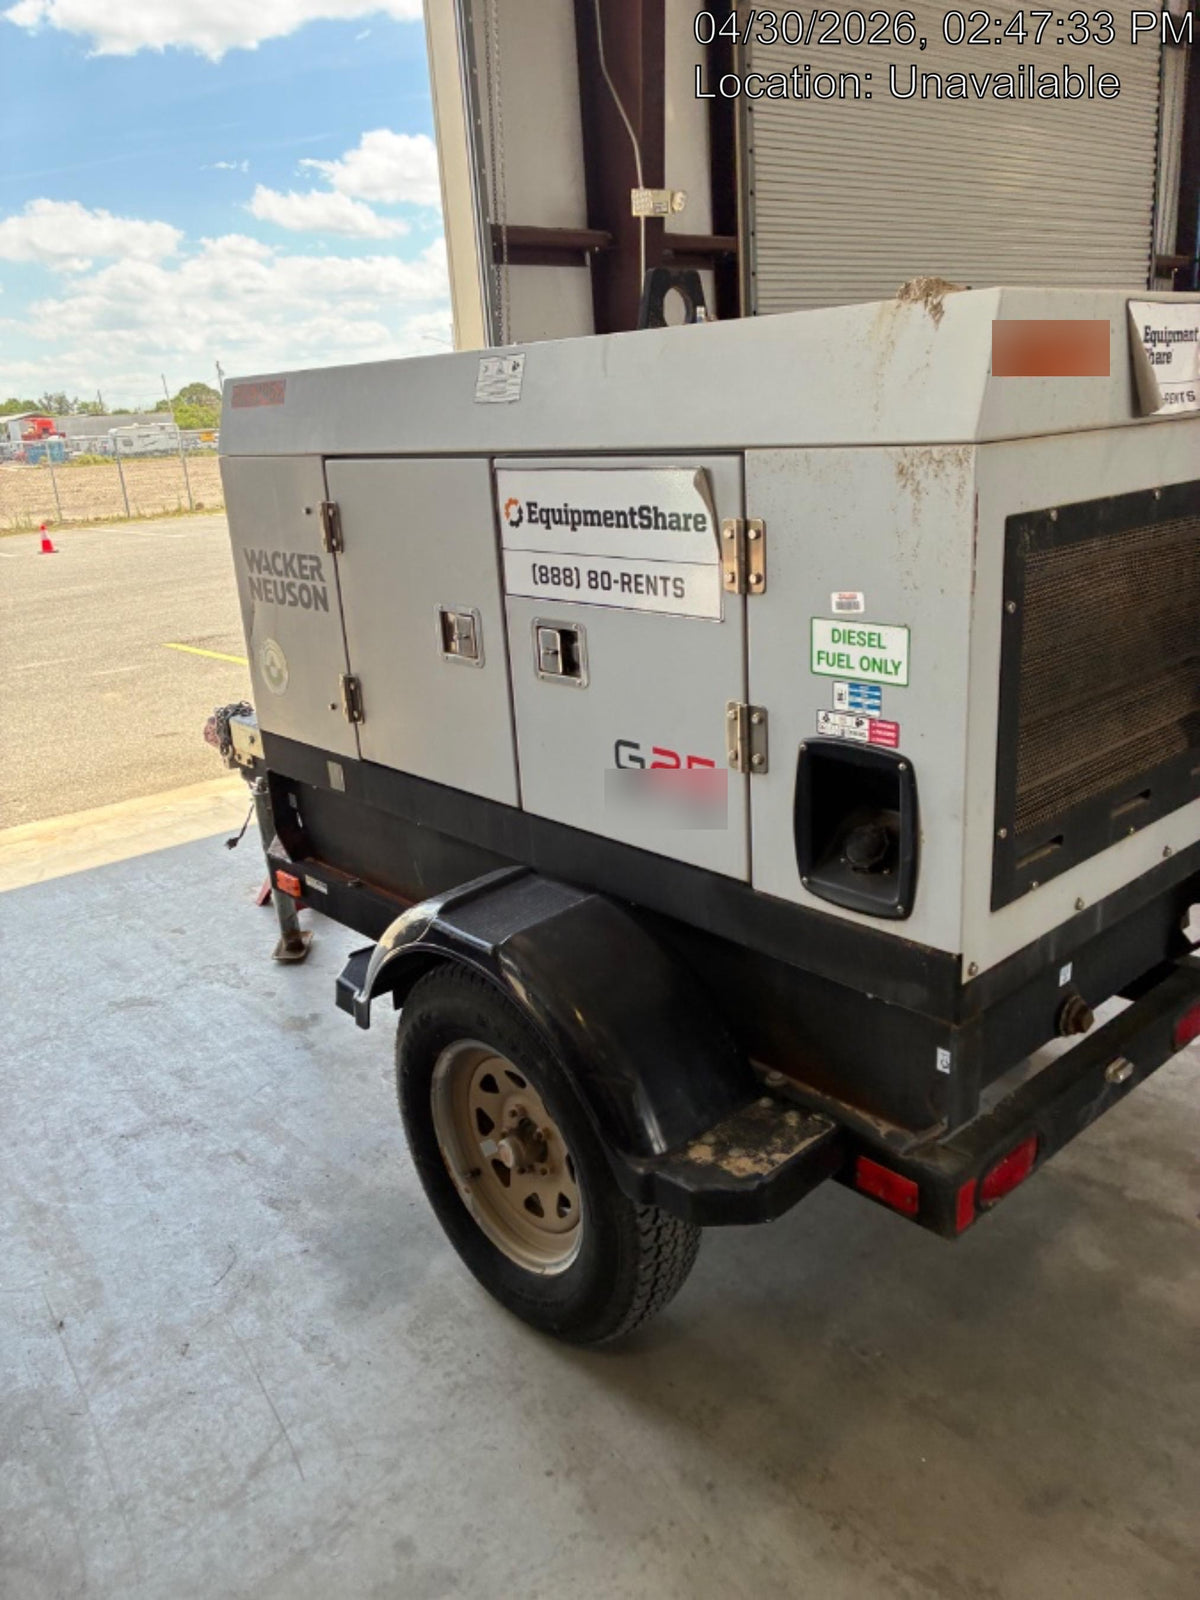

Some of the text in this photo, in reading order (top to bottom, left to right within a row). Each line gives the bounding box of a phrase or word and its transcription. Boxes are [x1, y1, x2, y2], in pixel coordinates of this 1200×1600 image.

[1143, 325, 1199, 348] Equipment
[1145, 349, 1173, 365] hare
[526, 501, 707, 532] EquipmentShare
[244, 548, 326, 582] WACKER
[249, 576, 329, 612] NEUSON
[532, 563, 685, 598] (888) 80-RENTS
[831, 628, 886, 649] DIESEL
[817, 650, 902, 676] FUEL ONLY
